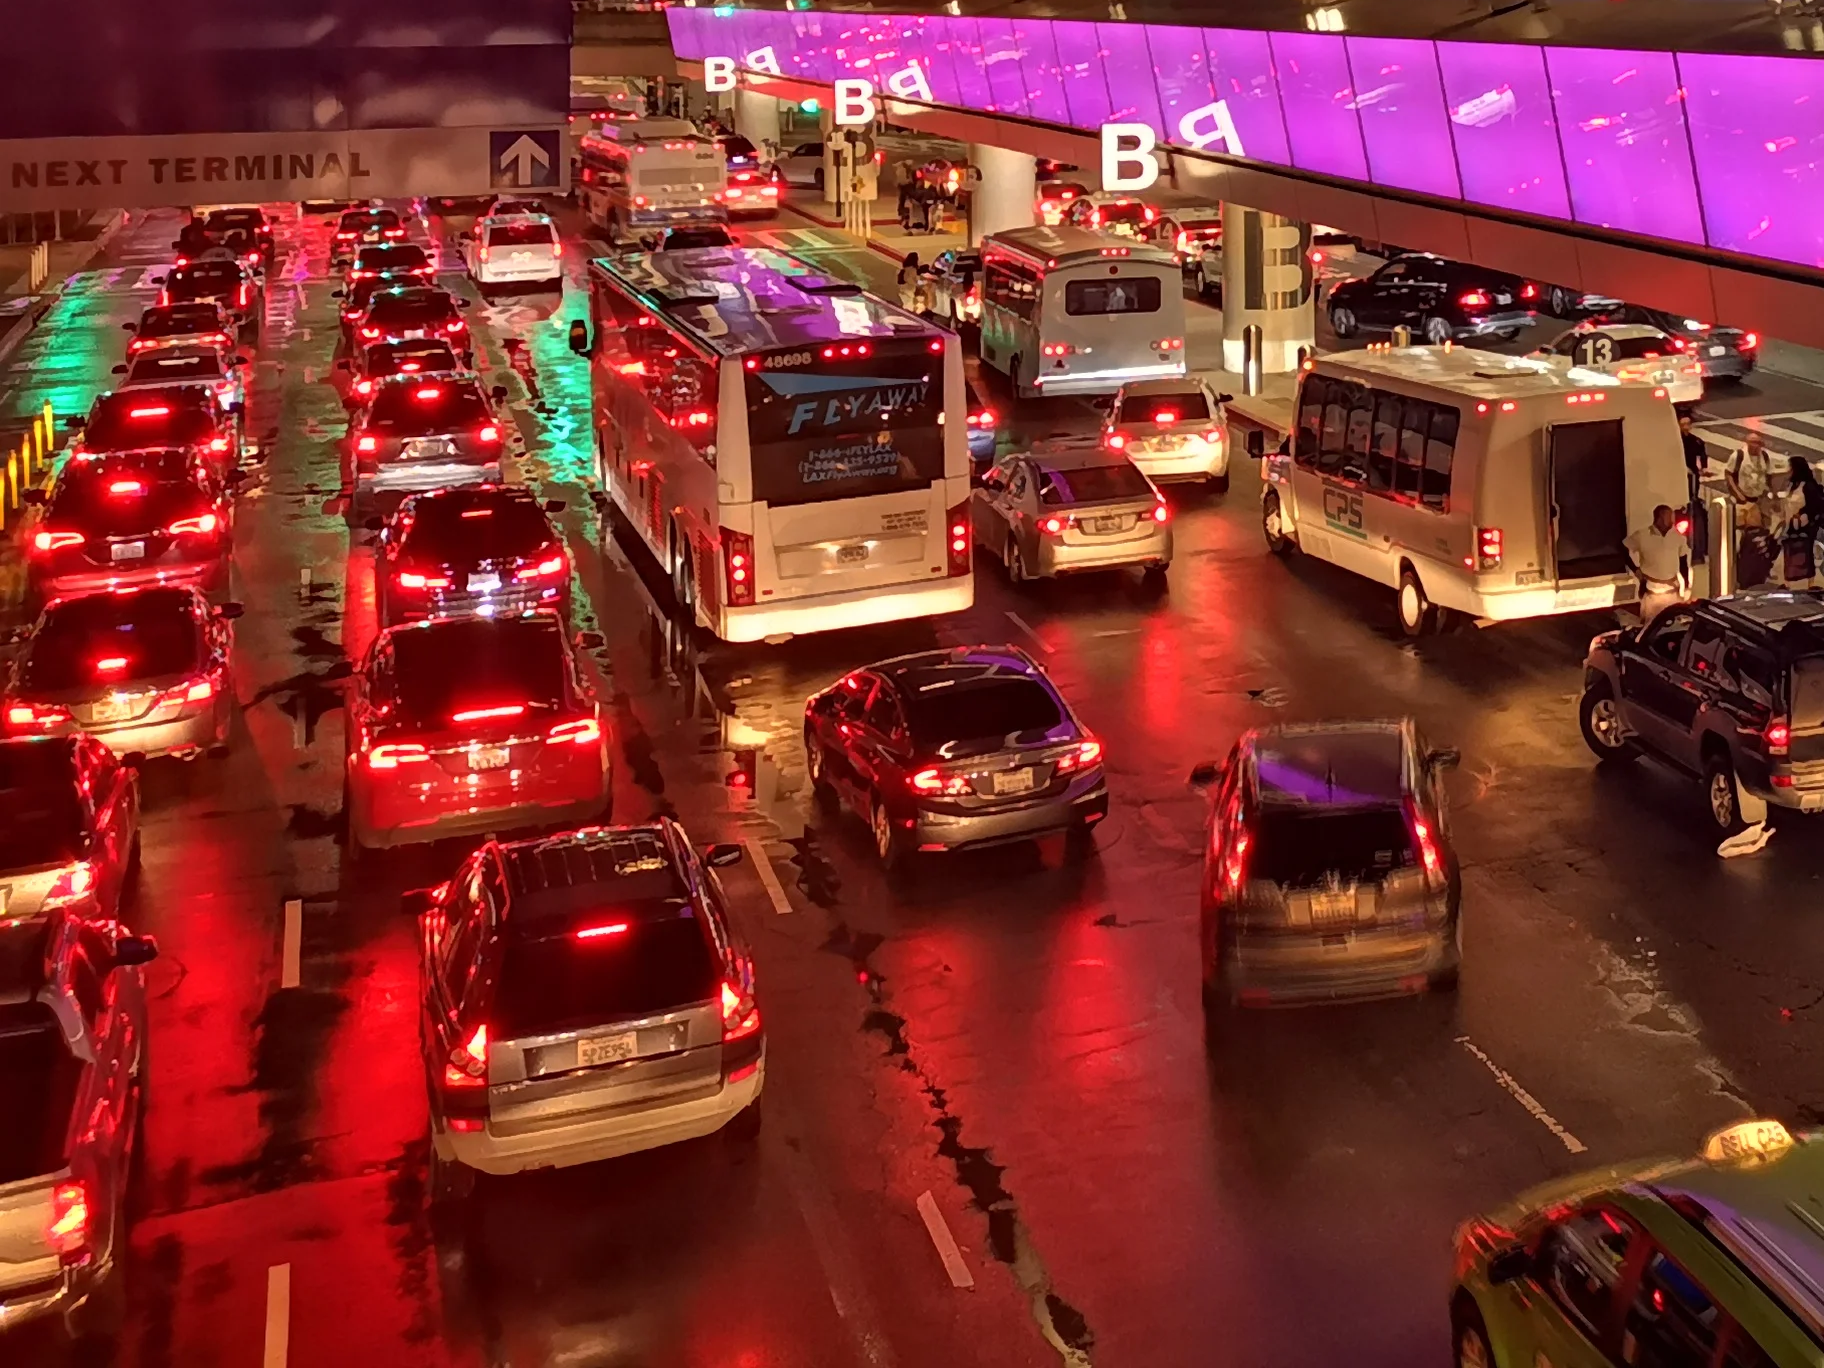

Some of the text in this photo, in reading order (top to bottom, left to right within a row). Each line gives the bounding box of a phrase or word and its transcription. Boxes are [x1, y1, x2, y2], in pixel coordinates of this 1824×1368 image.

[704, 56, 737, 93] B
[834, 78, 876, 126] B
[11, 152, 371, 189] NEXT TERMINAL
[1101, 122, 1159, 192] B
[1581, 338, 1613, 368] 13
[787, 384, 930, 435] FLYAWAY
[1323, 487, 1364, 530] CPS
